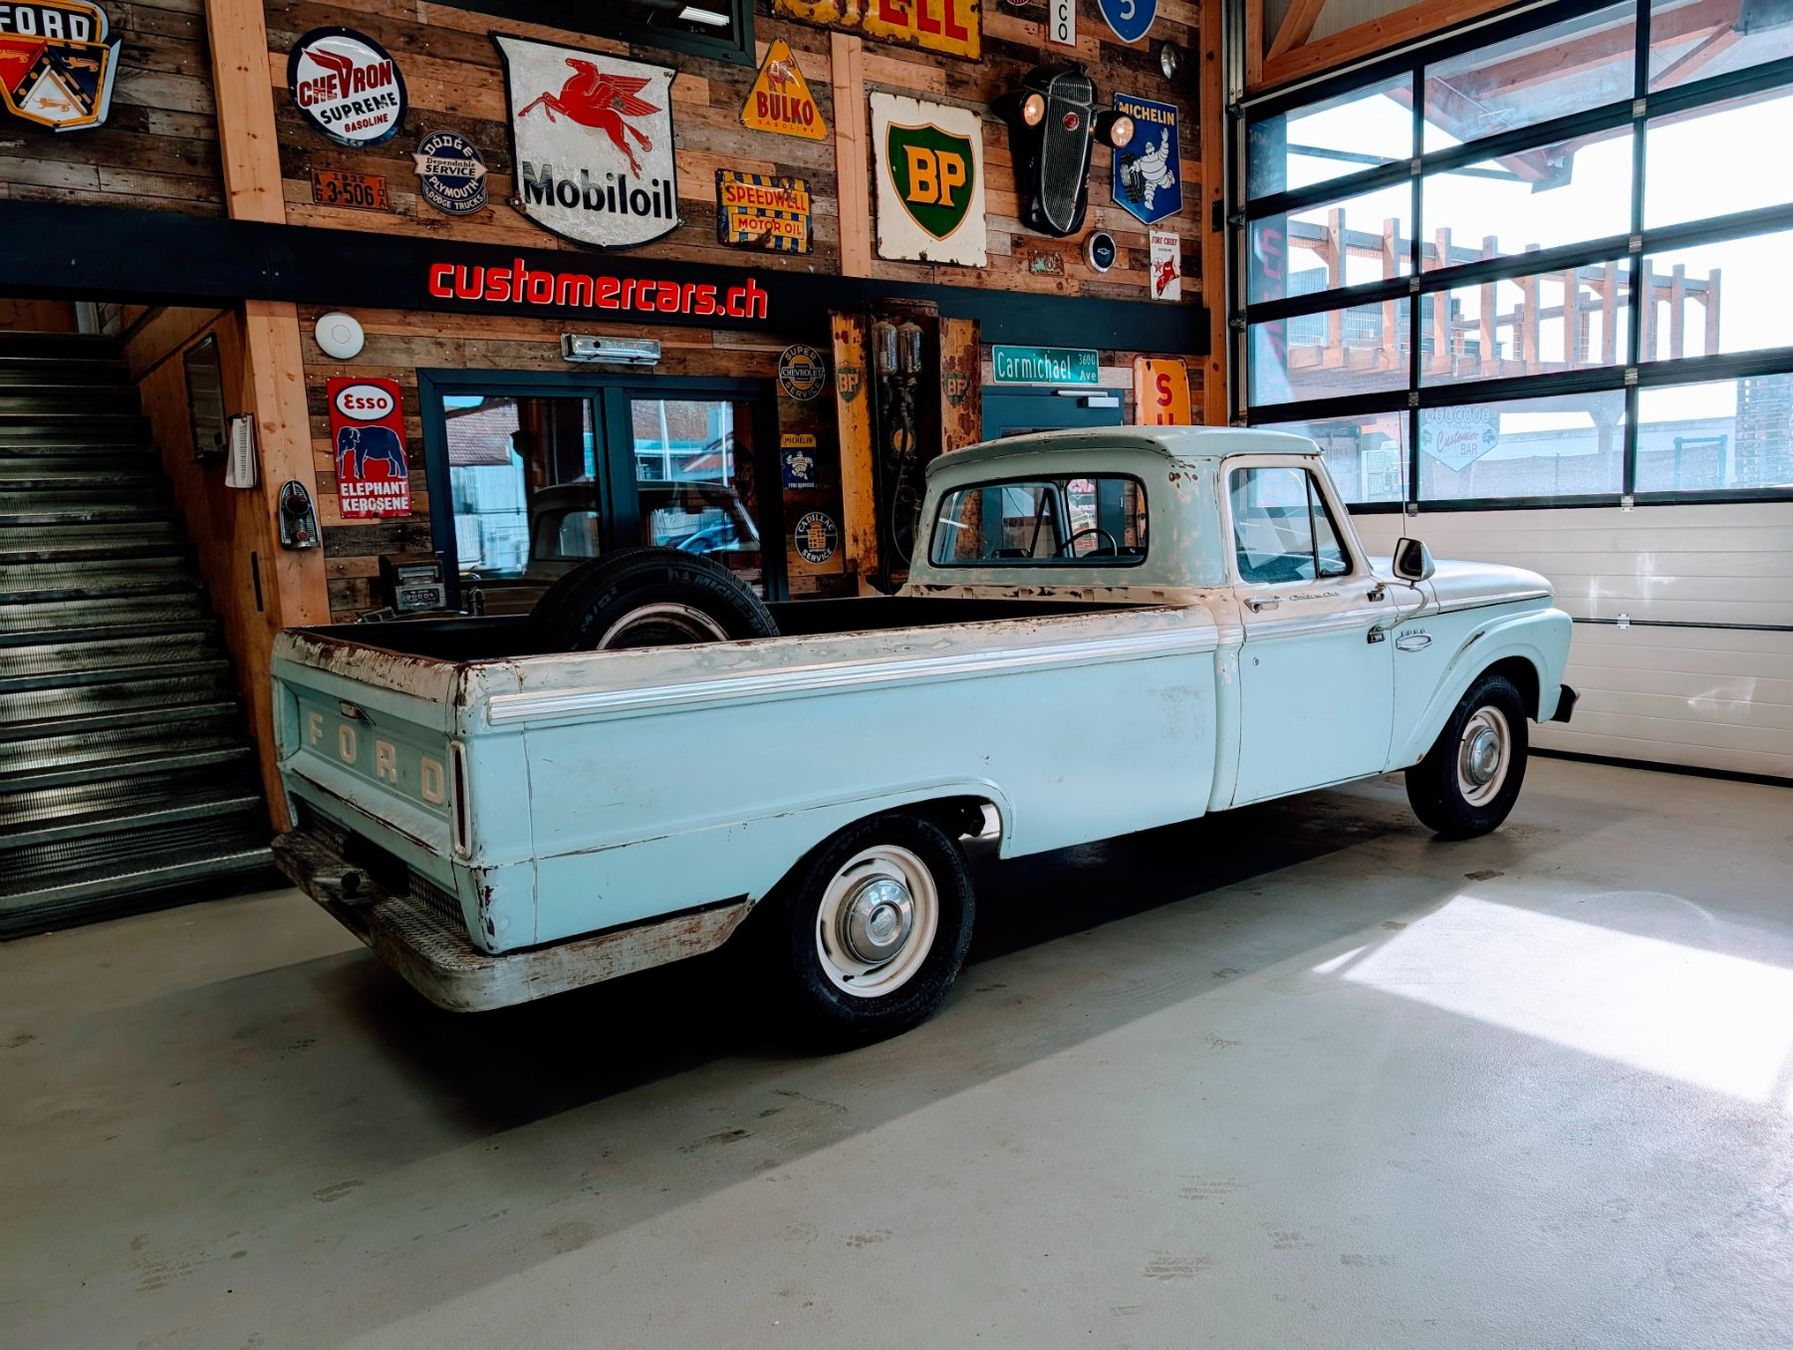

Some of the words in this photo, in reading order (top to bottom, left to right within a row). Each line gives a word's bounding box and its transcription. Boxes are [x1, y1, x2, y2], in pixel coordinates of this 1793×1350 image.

[0, 6, 90, 42] FORD
[299, 54, 392, 107] CHEVRON
[320, 92, 398, 124] SUPREME
[756, 91, 814, 126] BULKO
[1119, 102, 1175, 126] MICHELIN
[344, 113, 389, 133] GASOLINE
[424, 134, 474, 156] DODGE
[425, 164, 476, 176] SERVICE
[426, 157, 476, 168] Dependable
[902, 144, 967, 207] BP
[429, 176, 479, 199] PLYMOUTH
[522, 161, 673, 220] Mobiloil
[428, 191, 452, 208] DODGE
[455, 194, 484, 210] TRUCKS
[725, 184, 807, 212] SPEEDWELL
[738, 218, 781, 232] MOTOR
[784, 223, 803, 236] OIL
[428, 257, 768, 319] customercars.ch
[785, 346, 817, 361] SUPER
[782, 368, 823, 378] CHEVROLET
[998, 351, 1071, 380] Carmichael
[1080, 370, 1097, 382] Ave
[785, 381, 821, 399] SERVICE
[838, 373, 859, 393] BP
[947, 378, 966, 396] BP
[1460, 442, 1478, 456] BAR
[341, 481, 407, 496] ELEPHANT
[342, 497, 409, 512] KEROSENE
[798, 514, 834, 532] CADILLAC
[802, 547, 833, 561] SERVICE
[306, 714, 445, 806] FORD
